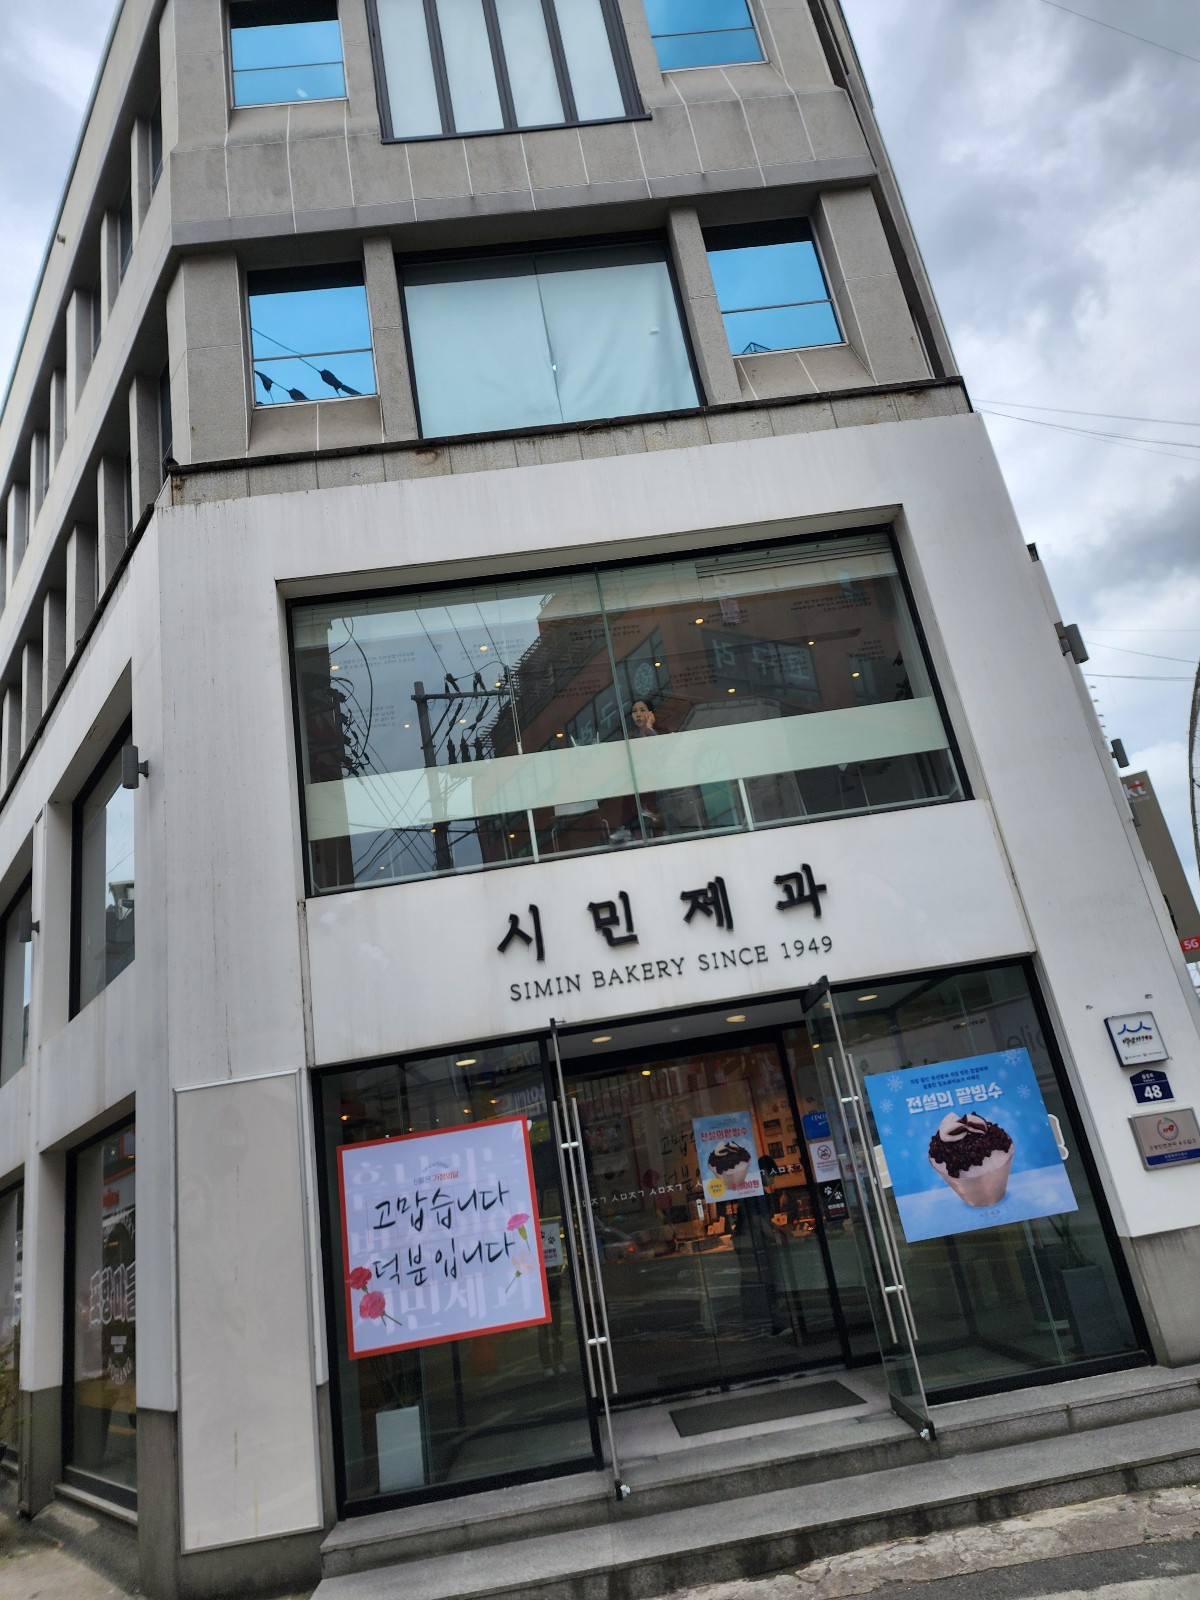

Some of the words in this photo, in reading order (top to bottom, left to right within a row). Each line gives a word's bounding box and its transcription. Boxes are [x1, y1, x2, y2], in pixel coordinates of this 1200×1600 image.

[497, 863, 827, 962] 시민제과
[510, 973, 582, 1002] SIMIN
[593, 957, 686, 989] BAKERY
[697, 945, 770, 972] SINCE
[781, 935, 834, 961] 1949
[1183, 939, 1199, 950] 5G
[905, 1090, 955, 1115] 전설의
[955, 1081, 1003, 1106] 팥빙수
[1144, 1084, 1163, 1099] 48
[372, 1180, 510, 1233] 고맙습니다
[372, 1232, 516, 1287] 덕분입니다
